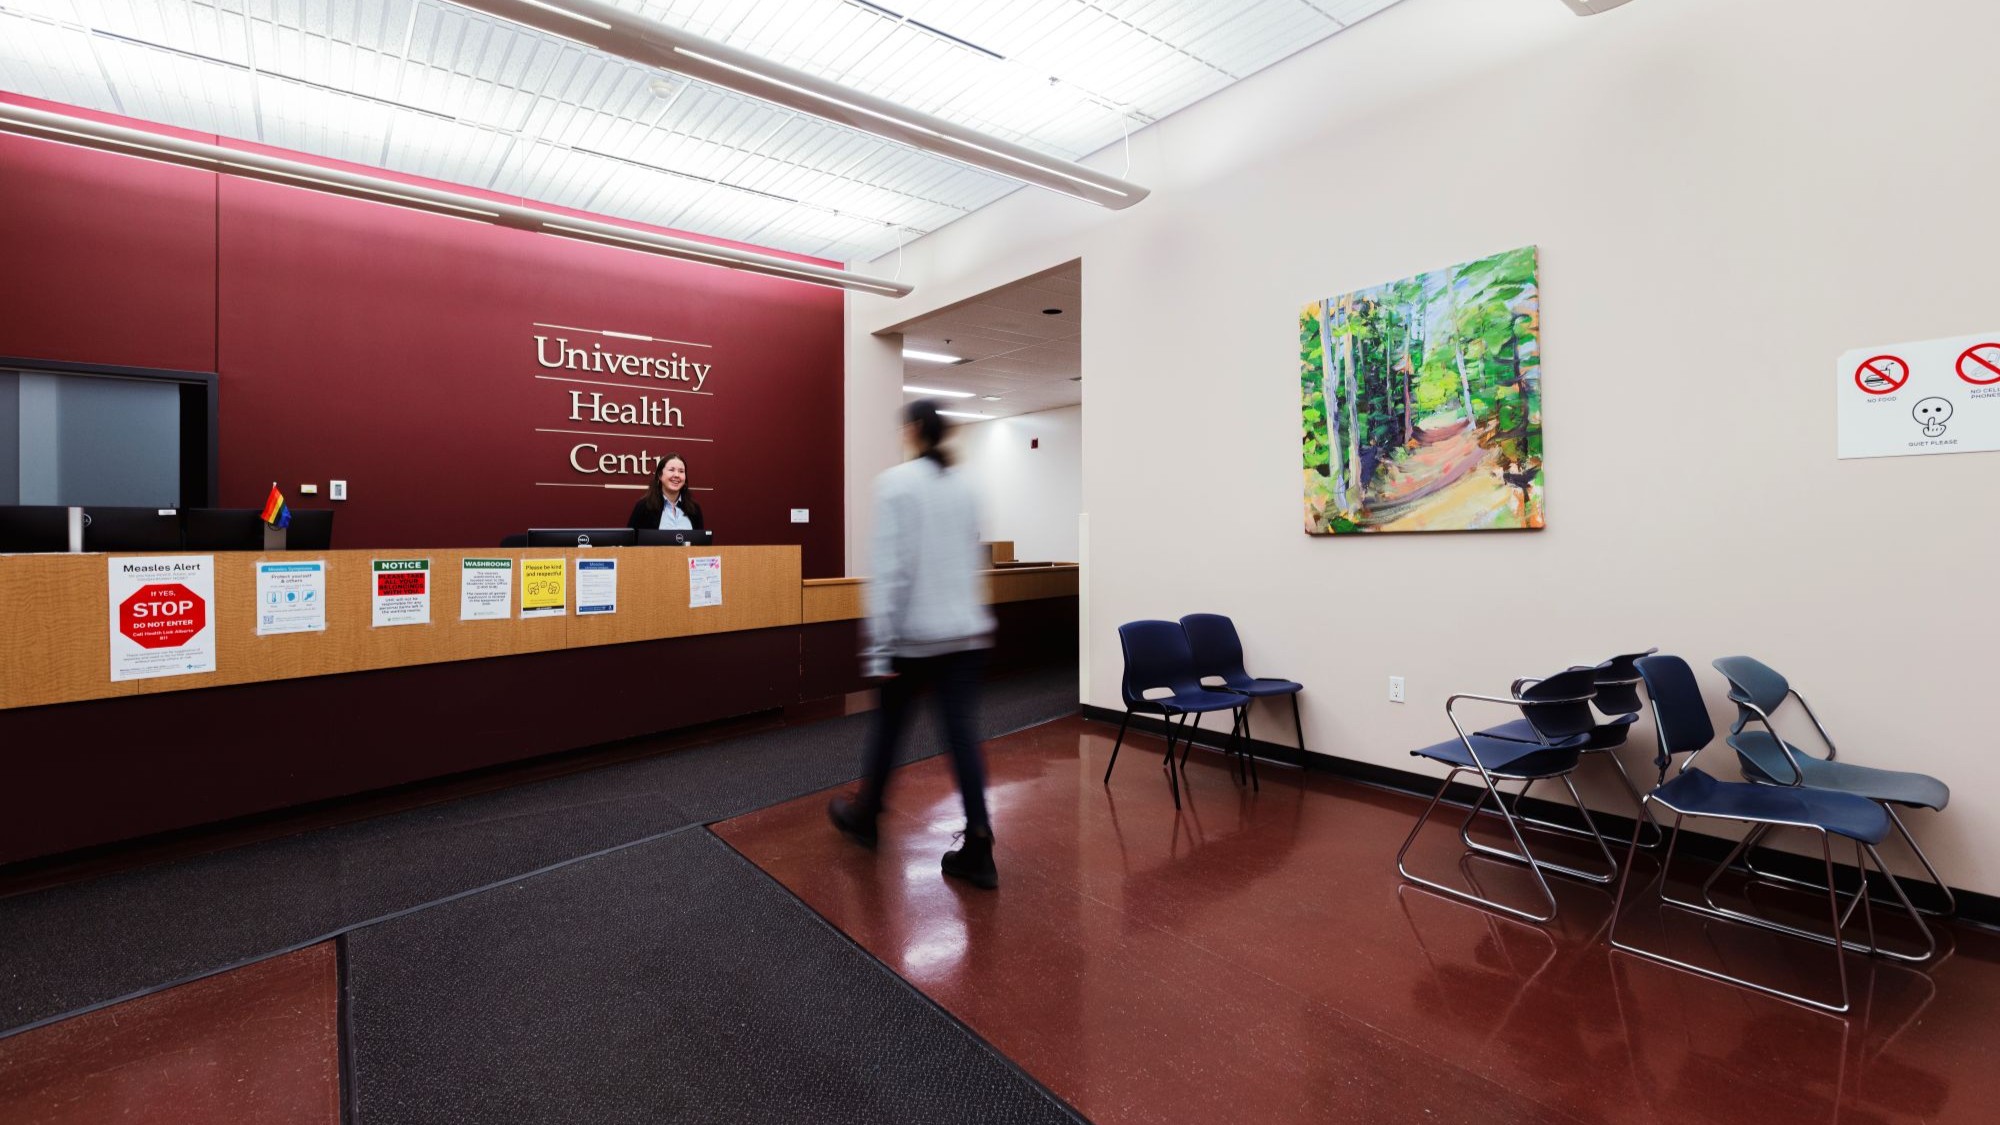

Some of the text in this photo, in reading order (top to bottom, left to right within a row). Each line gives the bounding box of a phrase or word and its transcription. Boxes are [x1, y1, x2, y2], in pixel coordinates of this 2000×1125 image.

[533, 335, 712, 391] University
[568, 390, 685, 428] Health
[569, 443, 665, 475] Cent
[123, 563, 200, 573] Measles Alert
[382, 561, 421, 569] NOTICE
[133, 600, 194, 618] STOP
